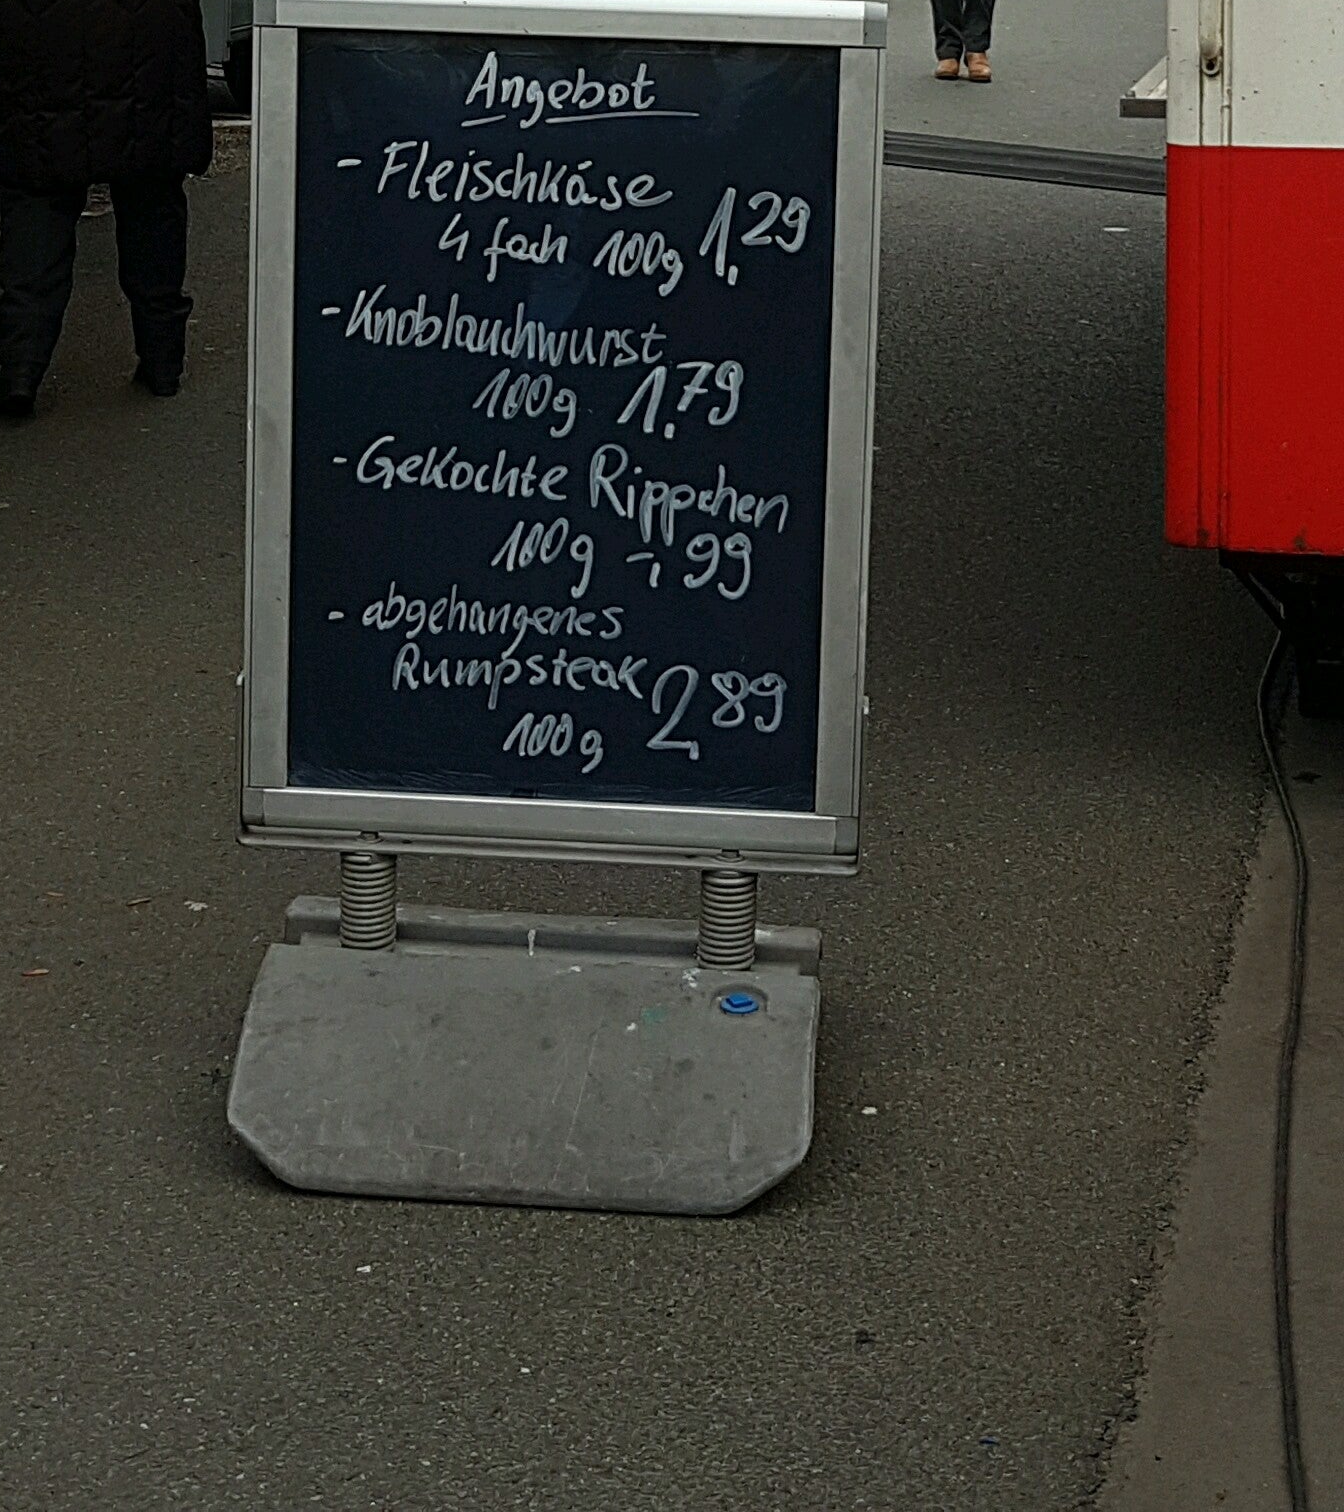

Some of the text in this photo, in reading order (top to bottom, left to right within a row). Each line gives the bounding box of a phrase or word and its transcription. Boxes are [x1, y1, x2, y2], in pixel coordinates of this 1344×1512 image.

[464, 51, 656, 129] Angebot
[438, 212, 463, 261] 4
[482, 217, 566, 282] fach
[592, 229, 684, 298] 100g
[344, 283, 668, 367] Knoblauchwurst
[471, 367, 578, 438] 100g
[588, 442, 790, 547] Rippchen
[361, 580, 626, 659] abgehangenes
